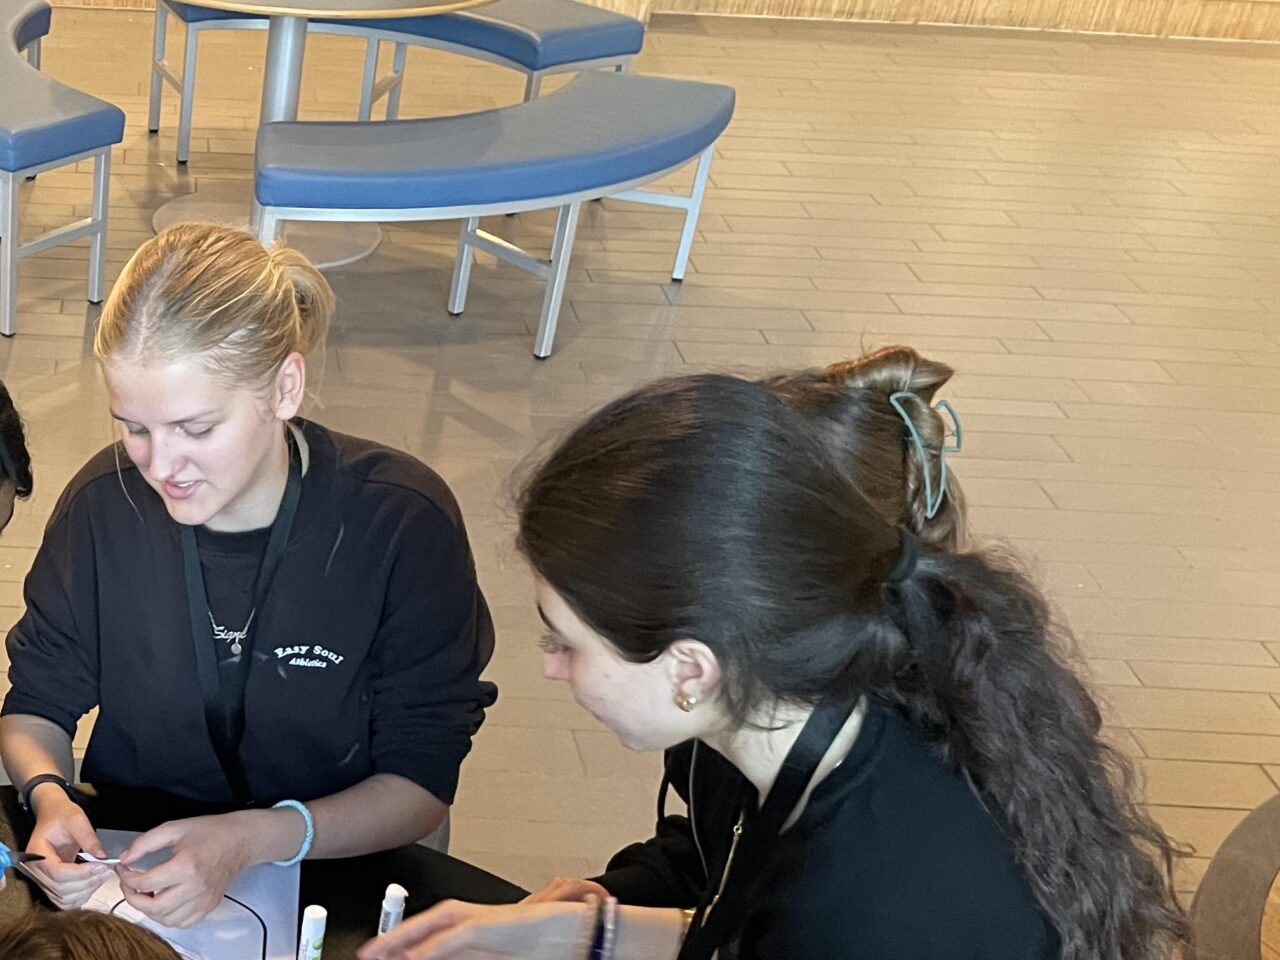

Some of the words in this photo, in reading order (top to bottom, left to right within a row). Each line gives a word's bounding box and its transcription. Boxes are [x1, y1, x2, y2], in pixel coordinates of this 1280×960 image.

[274, 645, 310, 659] Easy
[313, 645, 345, 665] Soul
[288, 657, 327, 668] Athletics
